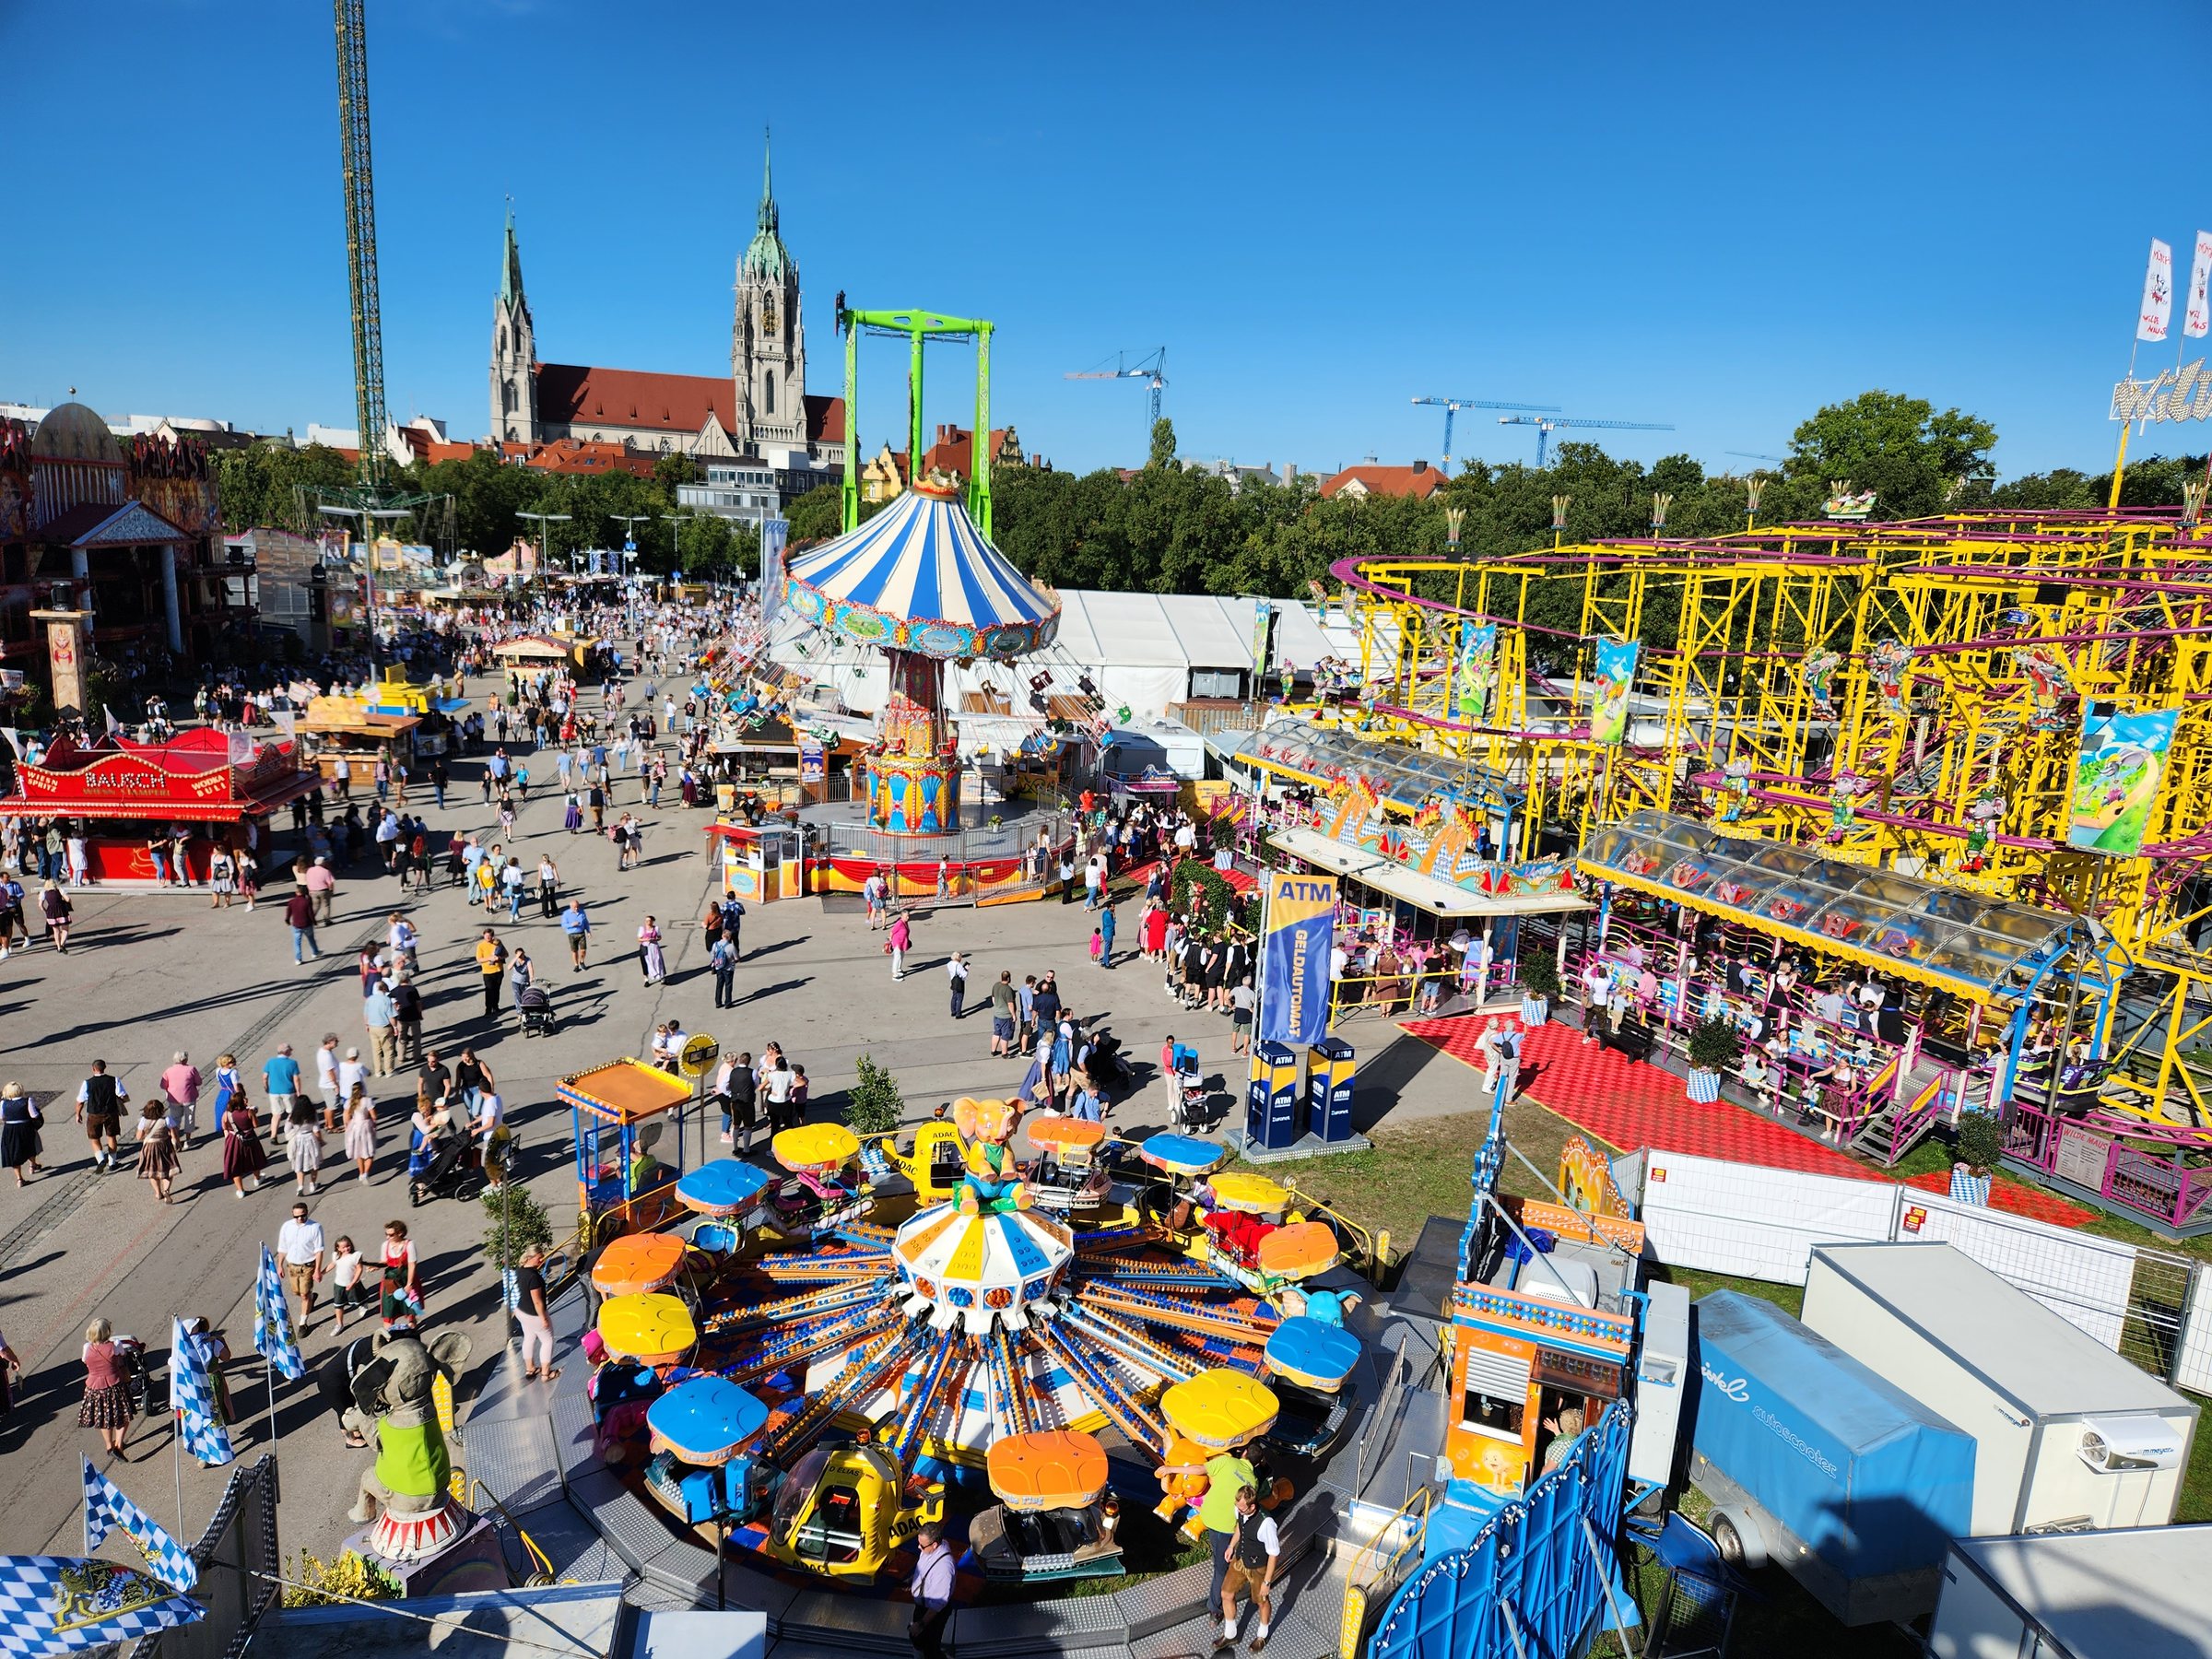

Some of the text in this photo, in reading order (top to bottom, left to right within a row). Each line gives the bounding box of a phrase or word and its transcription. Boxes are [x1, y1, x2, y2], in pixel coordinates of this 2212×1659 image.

[133, 430, 210, 481] PALAST
[27, 771, 58, 785] WIESN
[28, 778, 56, 793] SPRITZ
[85, 771, 165, 789] BAUSCH
[191, 774, 225, 791] WODKA
[1277, 882, 1331, 901] ATM
[1288, 929, 1308, 1038] GELDAUTOMAT
[1275, 1055, 1293, 1065] ATM
[1335, 1051, 1351, 1059] ATM
[2061, 1069, 2075, 1081] 2
[1275, 1096, 1292, 1105] ATM
[1334, 1089, 1350, 1100] ATM
[933, 1131, 955, 1139] ADAC
[2064, 1128, 2108, 1151] WILDE MAUS
[892, 1158, 918, 1176] ADAC
[1752, 1406, 1836, 1478] autoscooter
[837, 1467, 860, 1477] ELIAS
[888, 1515, 925, 1540] ADAC
